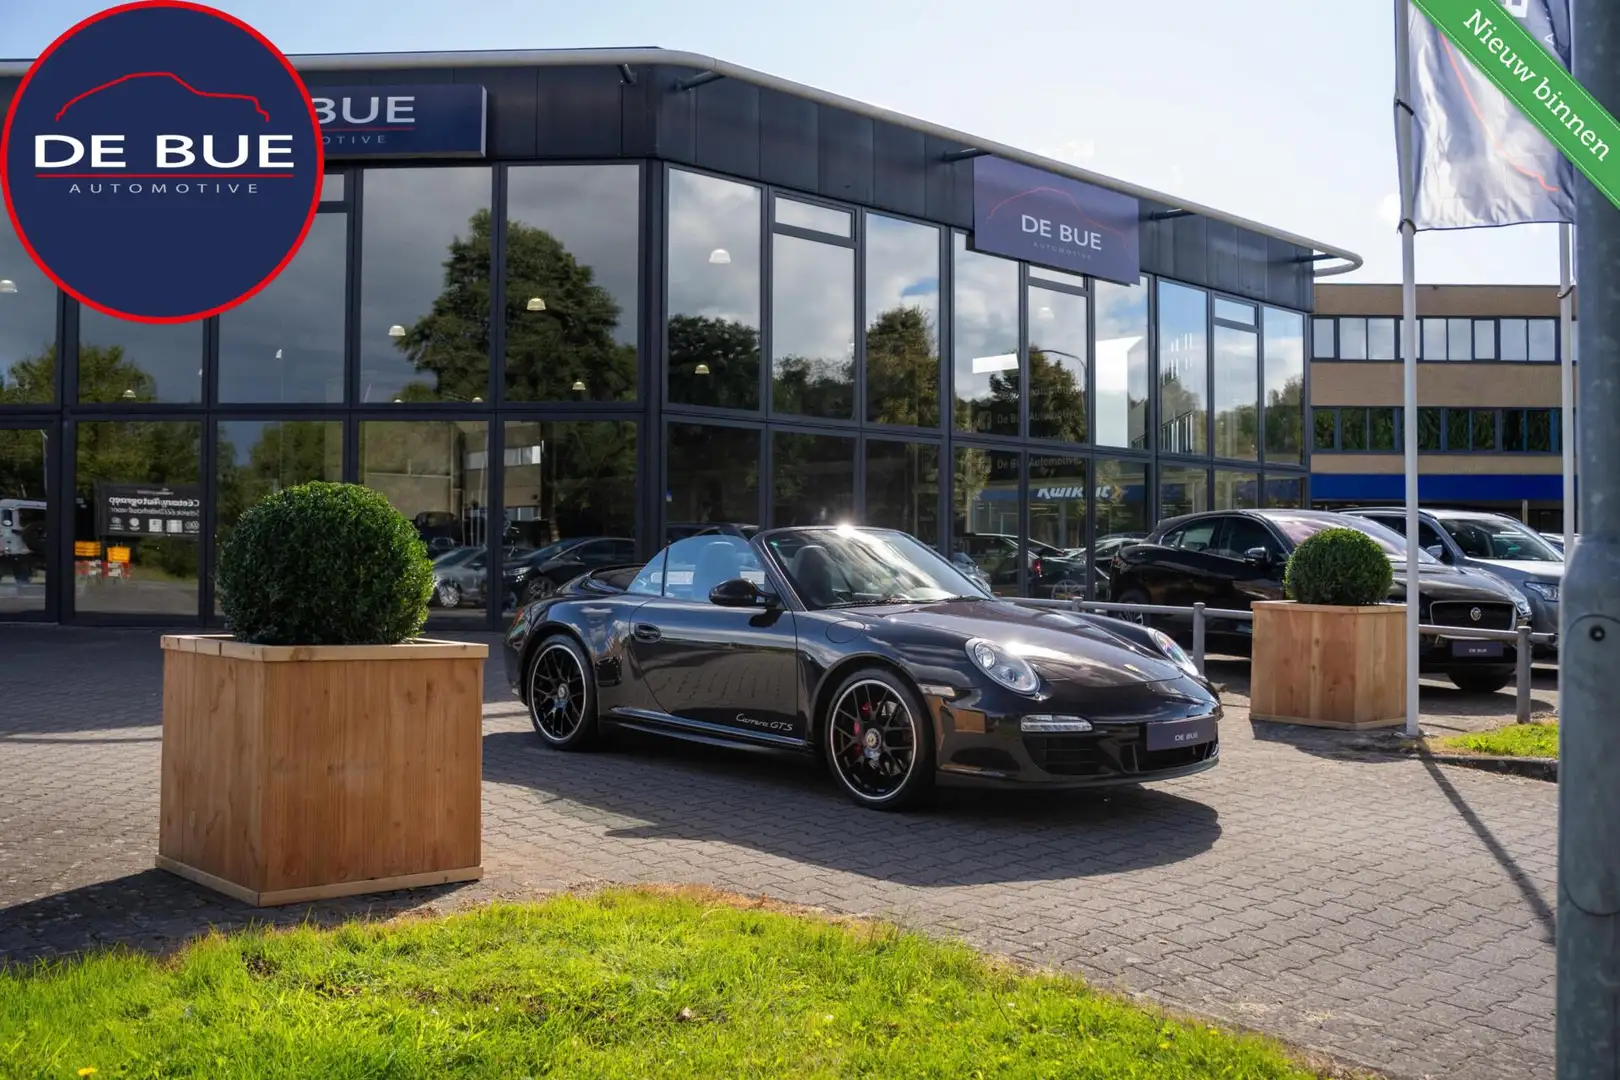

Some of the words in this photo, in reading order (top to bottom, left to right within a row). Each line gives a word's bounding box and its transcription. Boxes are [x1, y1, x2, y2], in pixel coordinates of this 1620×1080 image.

[322, 135, 387, 145] OTIVE
[1021, 214, 1052, 238] DE
[1059, 224, 1102, 251] BUE
[1032, 241, 1092, 261] AUTOMOTIVE
[736, 713, 769, 728] Carrera
[770, 721, 794, 731] GTS
